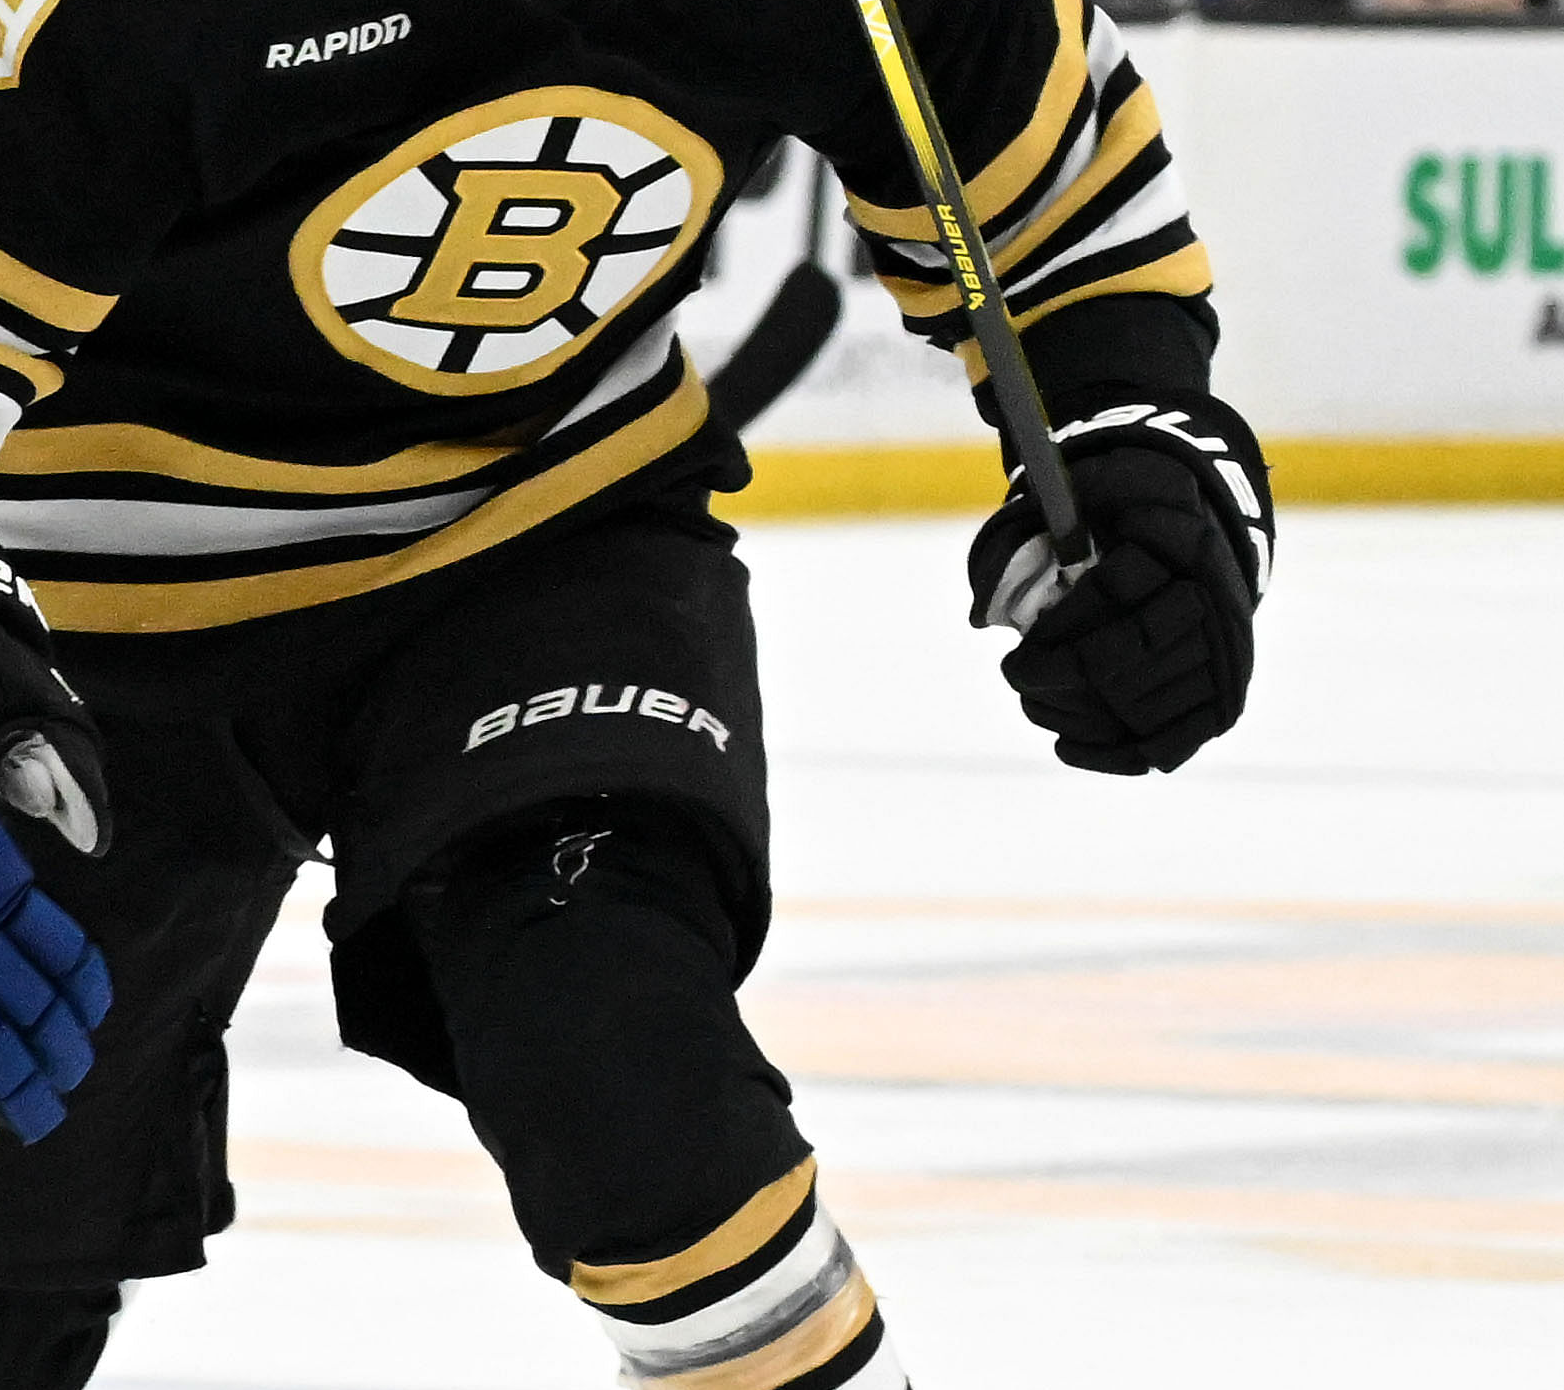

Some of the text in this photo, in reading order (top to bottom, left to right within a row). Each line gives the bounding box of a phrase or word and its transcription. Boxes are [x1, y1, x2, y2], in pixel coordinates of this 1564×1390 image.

[265, 13, 412, 69] RAPID7
[937, 205, 983, 290] BAUER
[462, 684, 731, 753] BAUER
